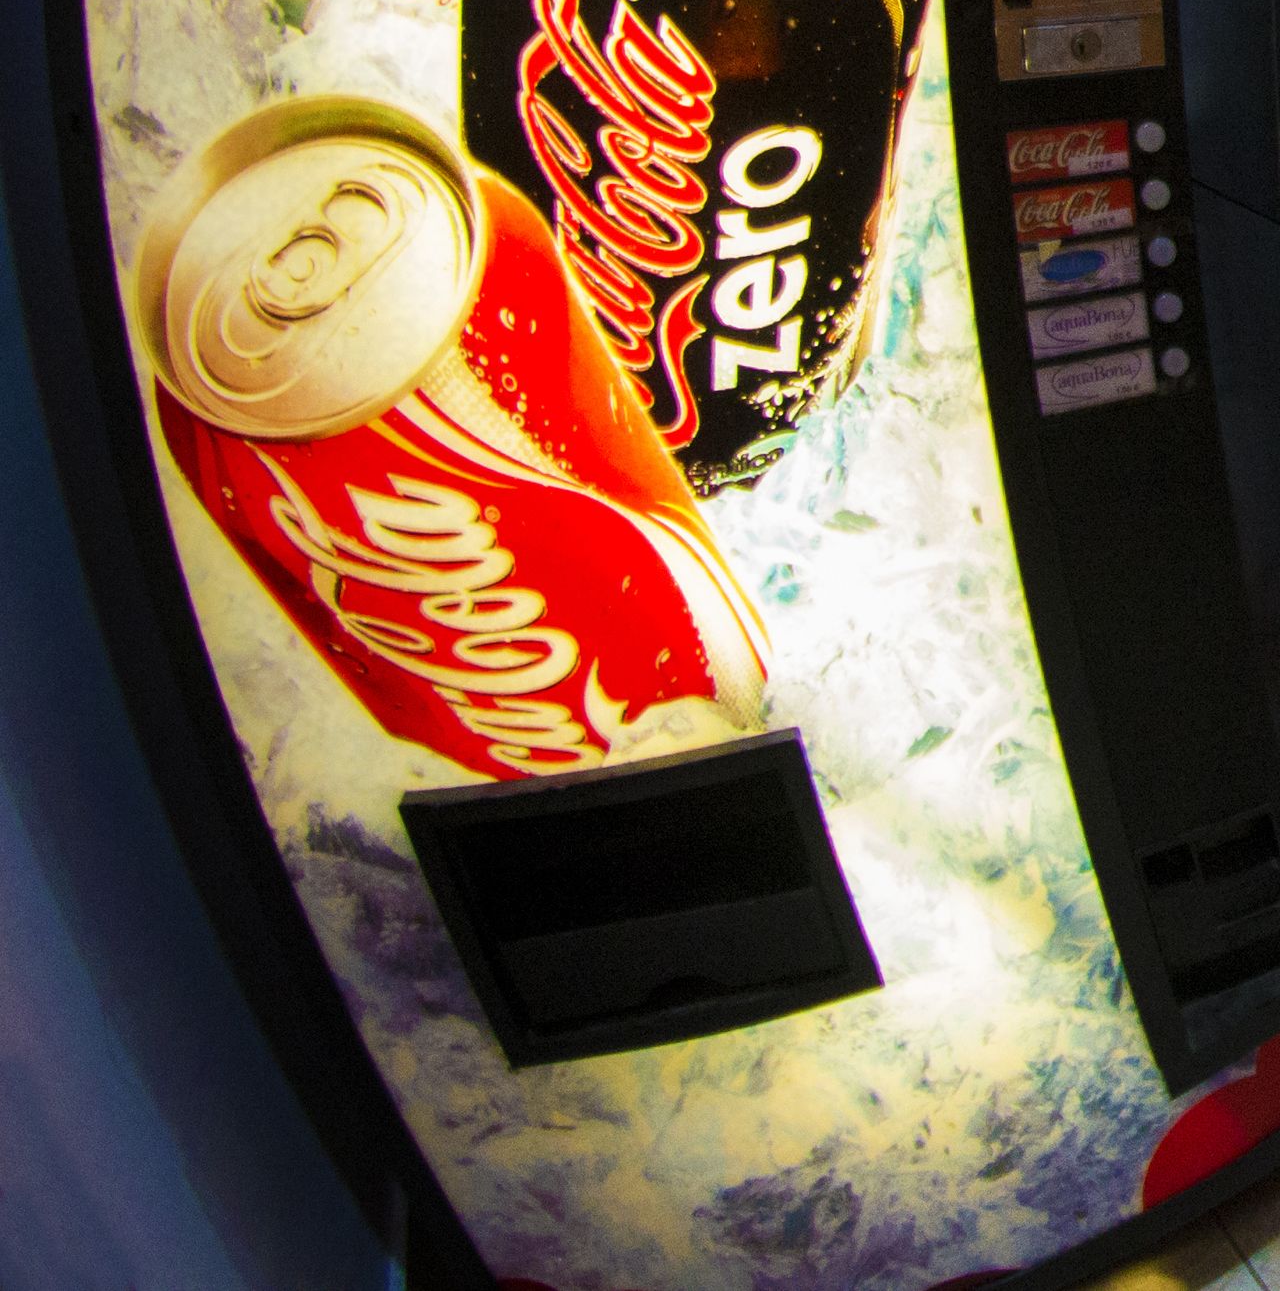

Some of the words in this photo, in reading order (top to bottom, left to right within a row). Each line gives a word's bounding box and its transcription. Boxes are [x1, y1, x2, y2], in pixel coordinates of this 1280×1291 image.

[1009, 128, 1106, 173] Coca-Cola
[1015, 186, 1111, 233] Coca-Cola
[711, 124, 824, 392] zero
